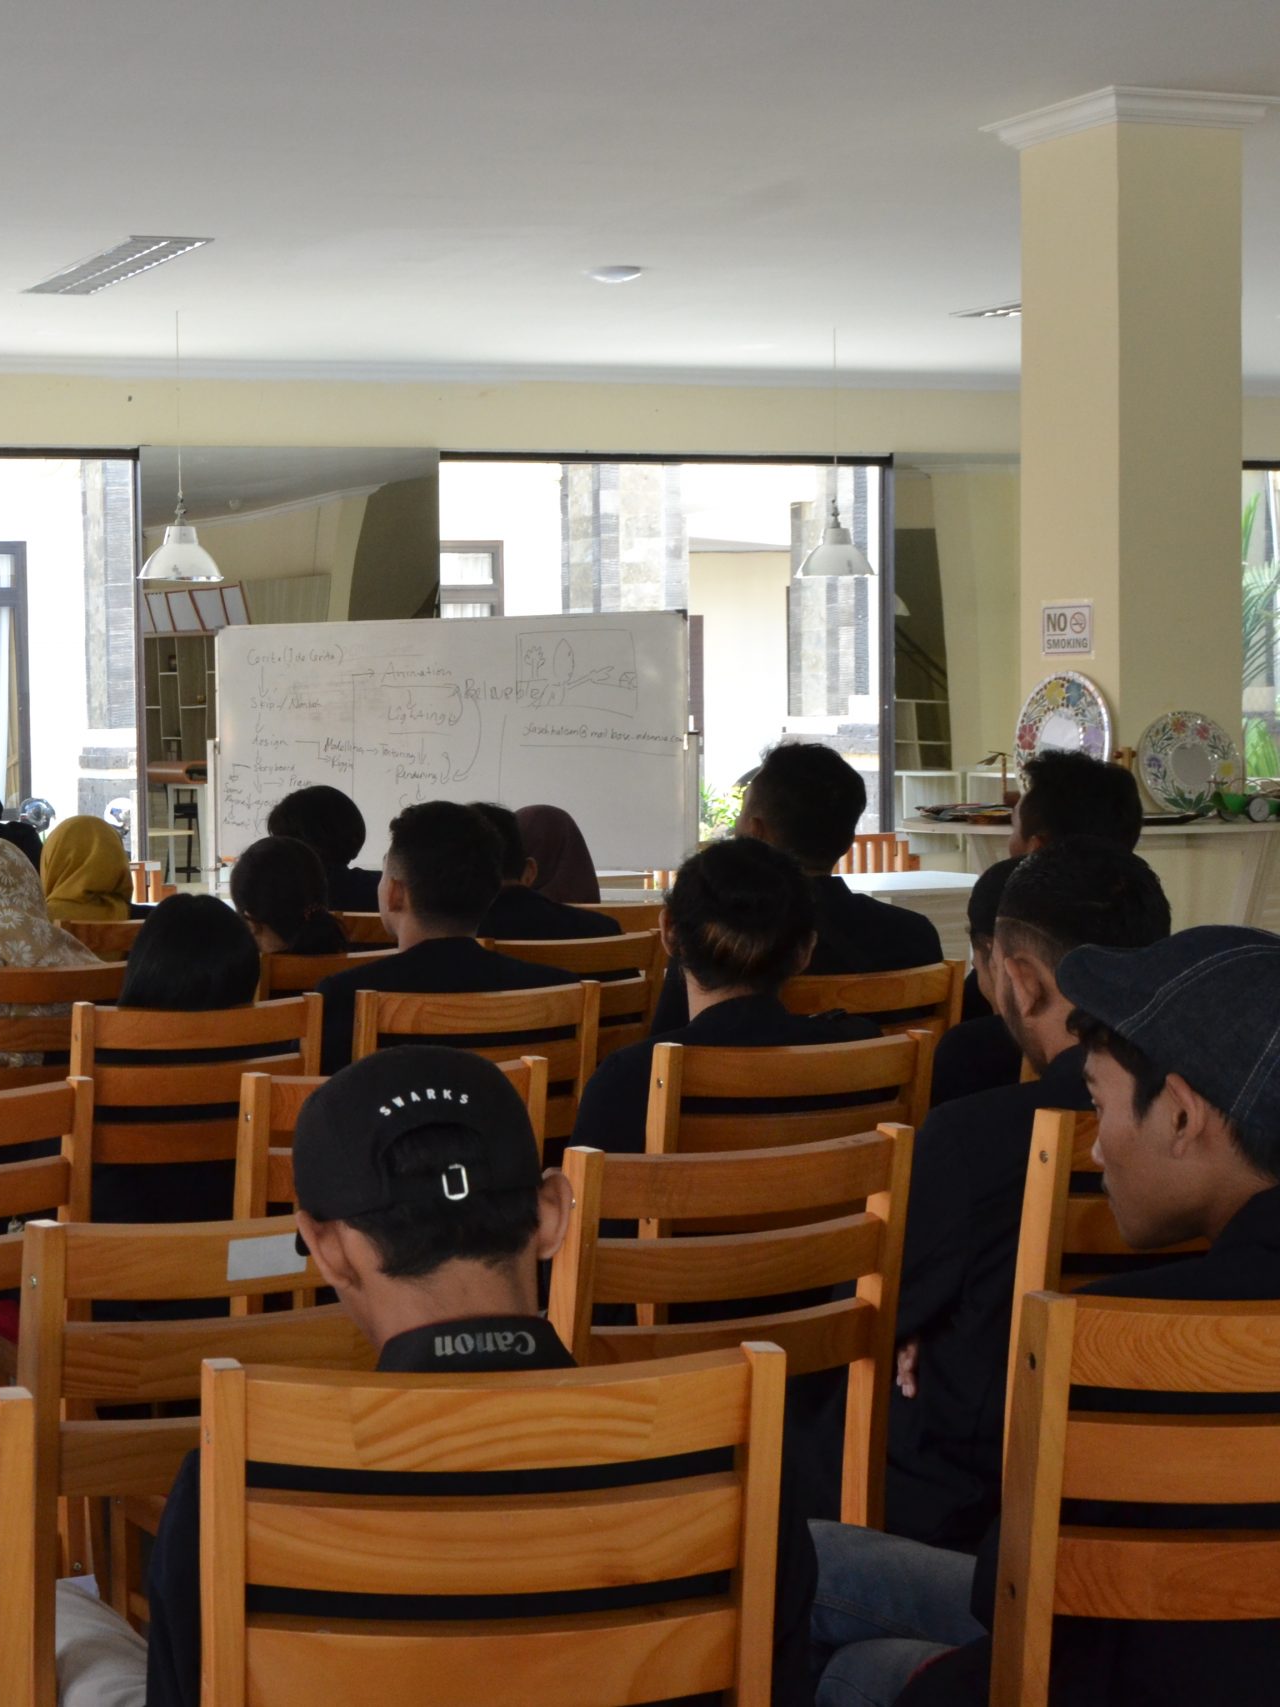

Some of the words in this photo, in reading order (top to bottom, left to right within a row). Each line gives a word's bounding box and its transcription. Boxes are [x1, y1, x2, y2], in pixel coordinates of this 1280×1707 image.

[1046, 612, 1068, 633] NO
[1046, 637, 1089, 650] SMOKING
[379, 1088, 469, 1117] SWARKS
[434, 1330, 536, 1357] Canon
